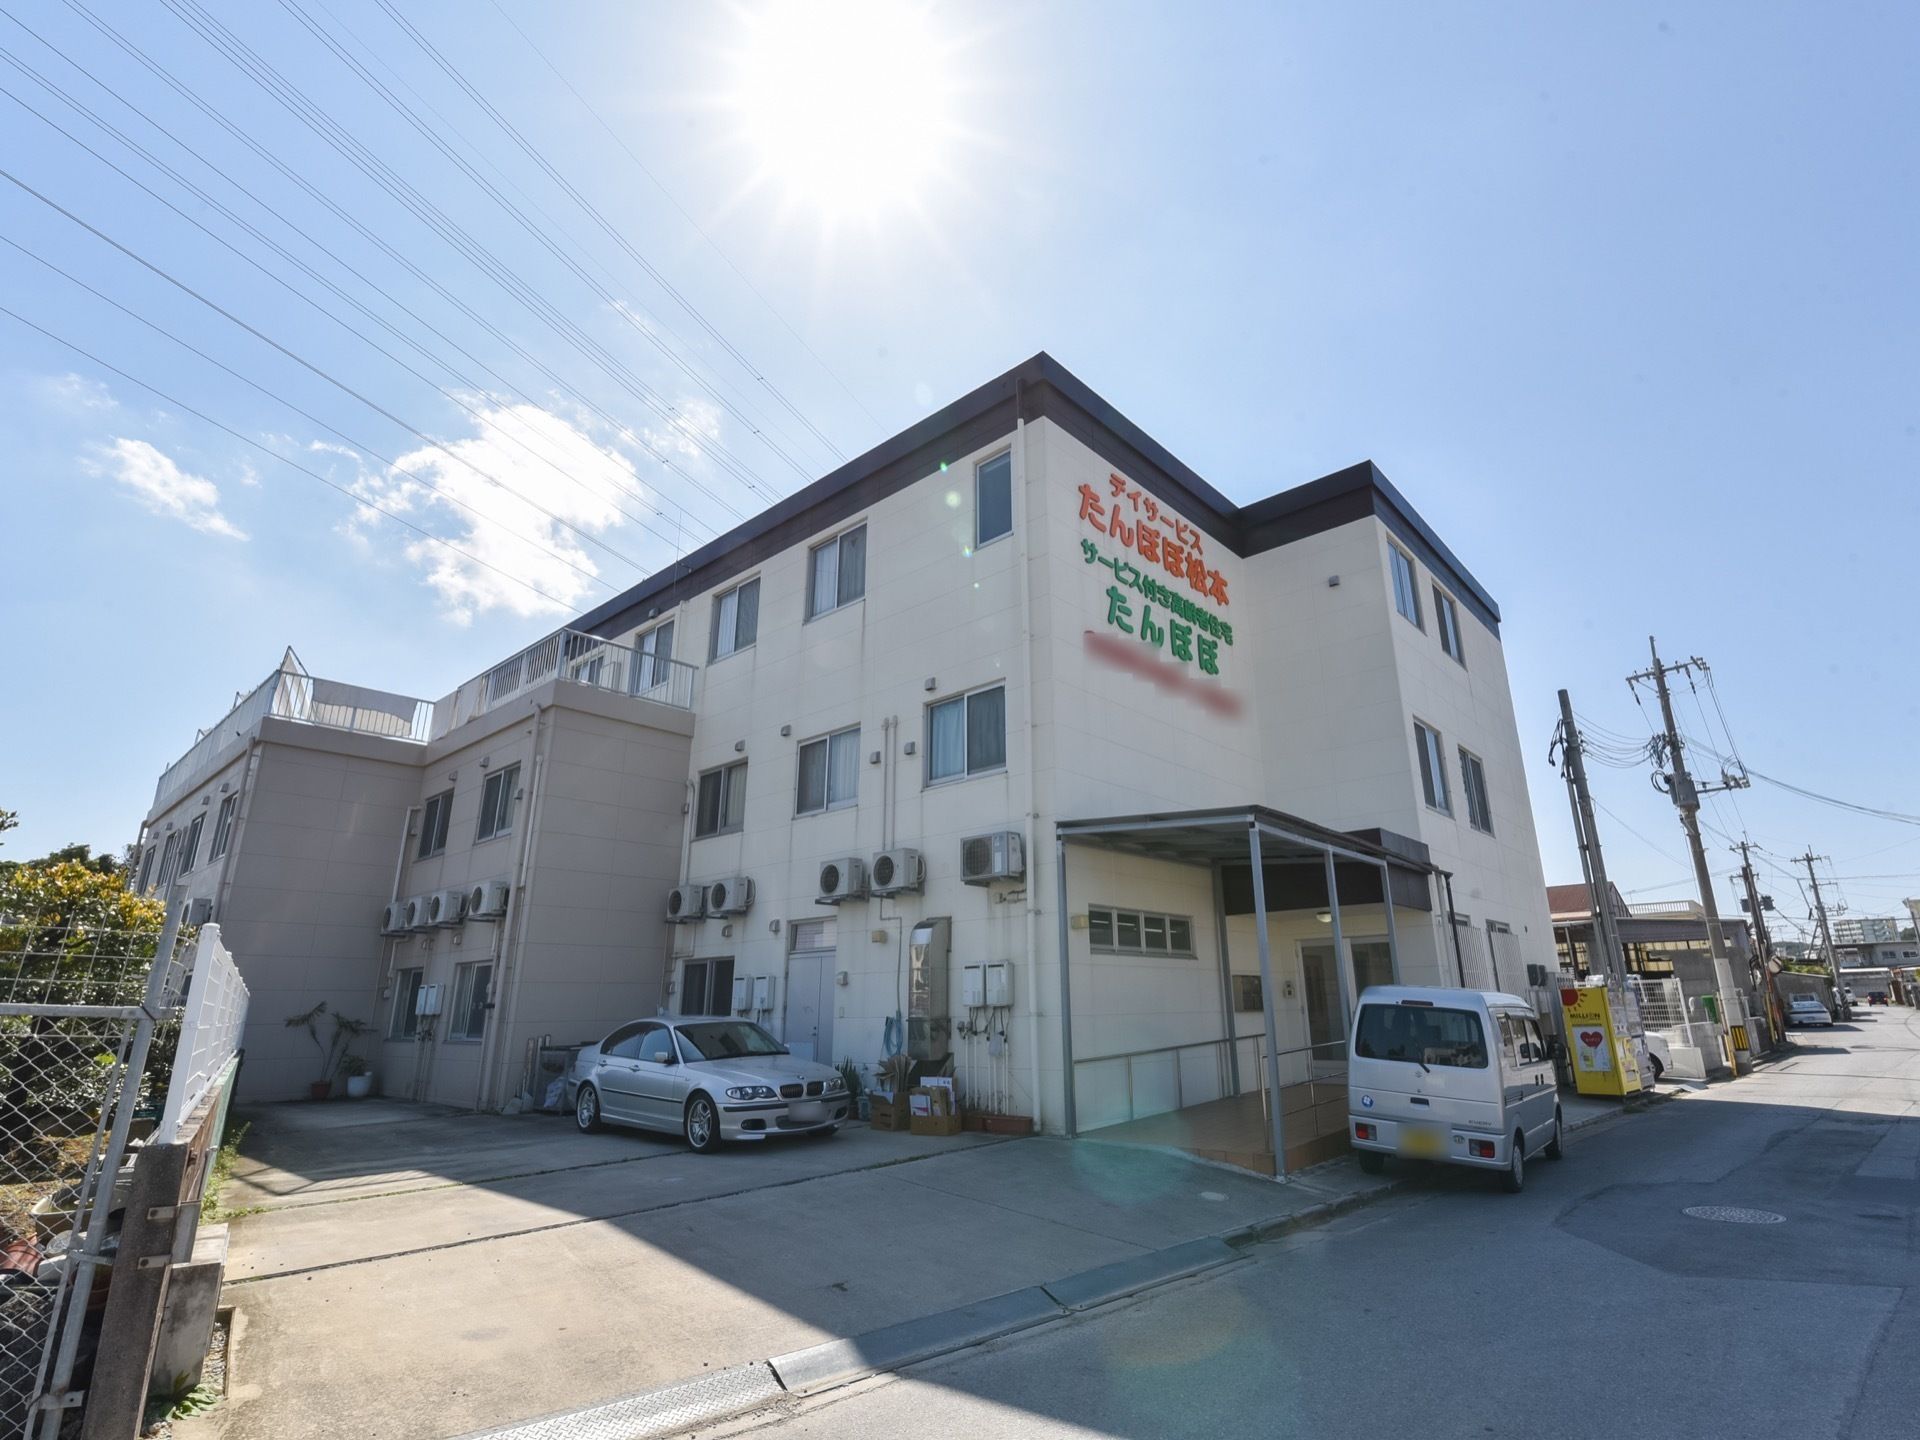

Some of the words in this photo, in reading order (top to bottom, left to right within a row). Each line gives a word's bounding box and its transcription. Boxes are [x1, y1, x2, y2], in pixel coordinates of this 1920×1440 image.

[1079, 484, 1229, 605] たんぽぽ松本
[1110, 474, 1203, 553] デイサービス
[1081, 538, 1233, 645] サービス付き高齢者住宅
[1107, 587, 1219, 675] たんぽぽ
